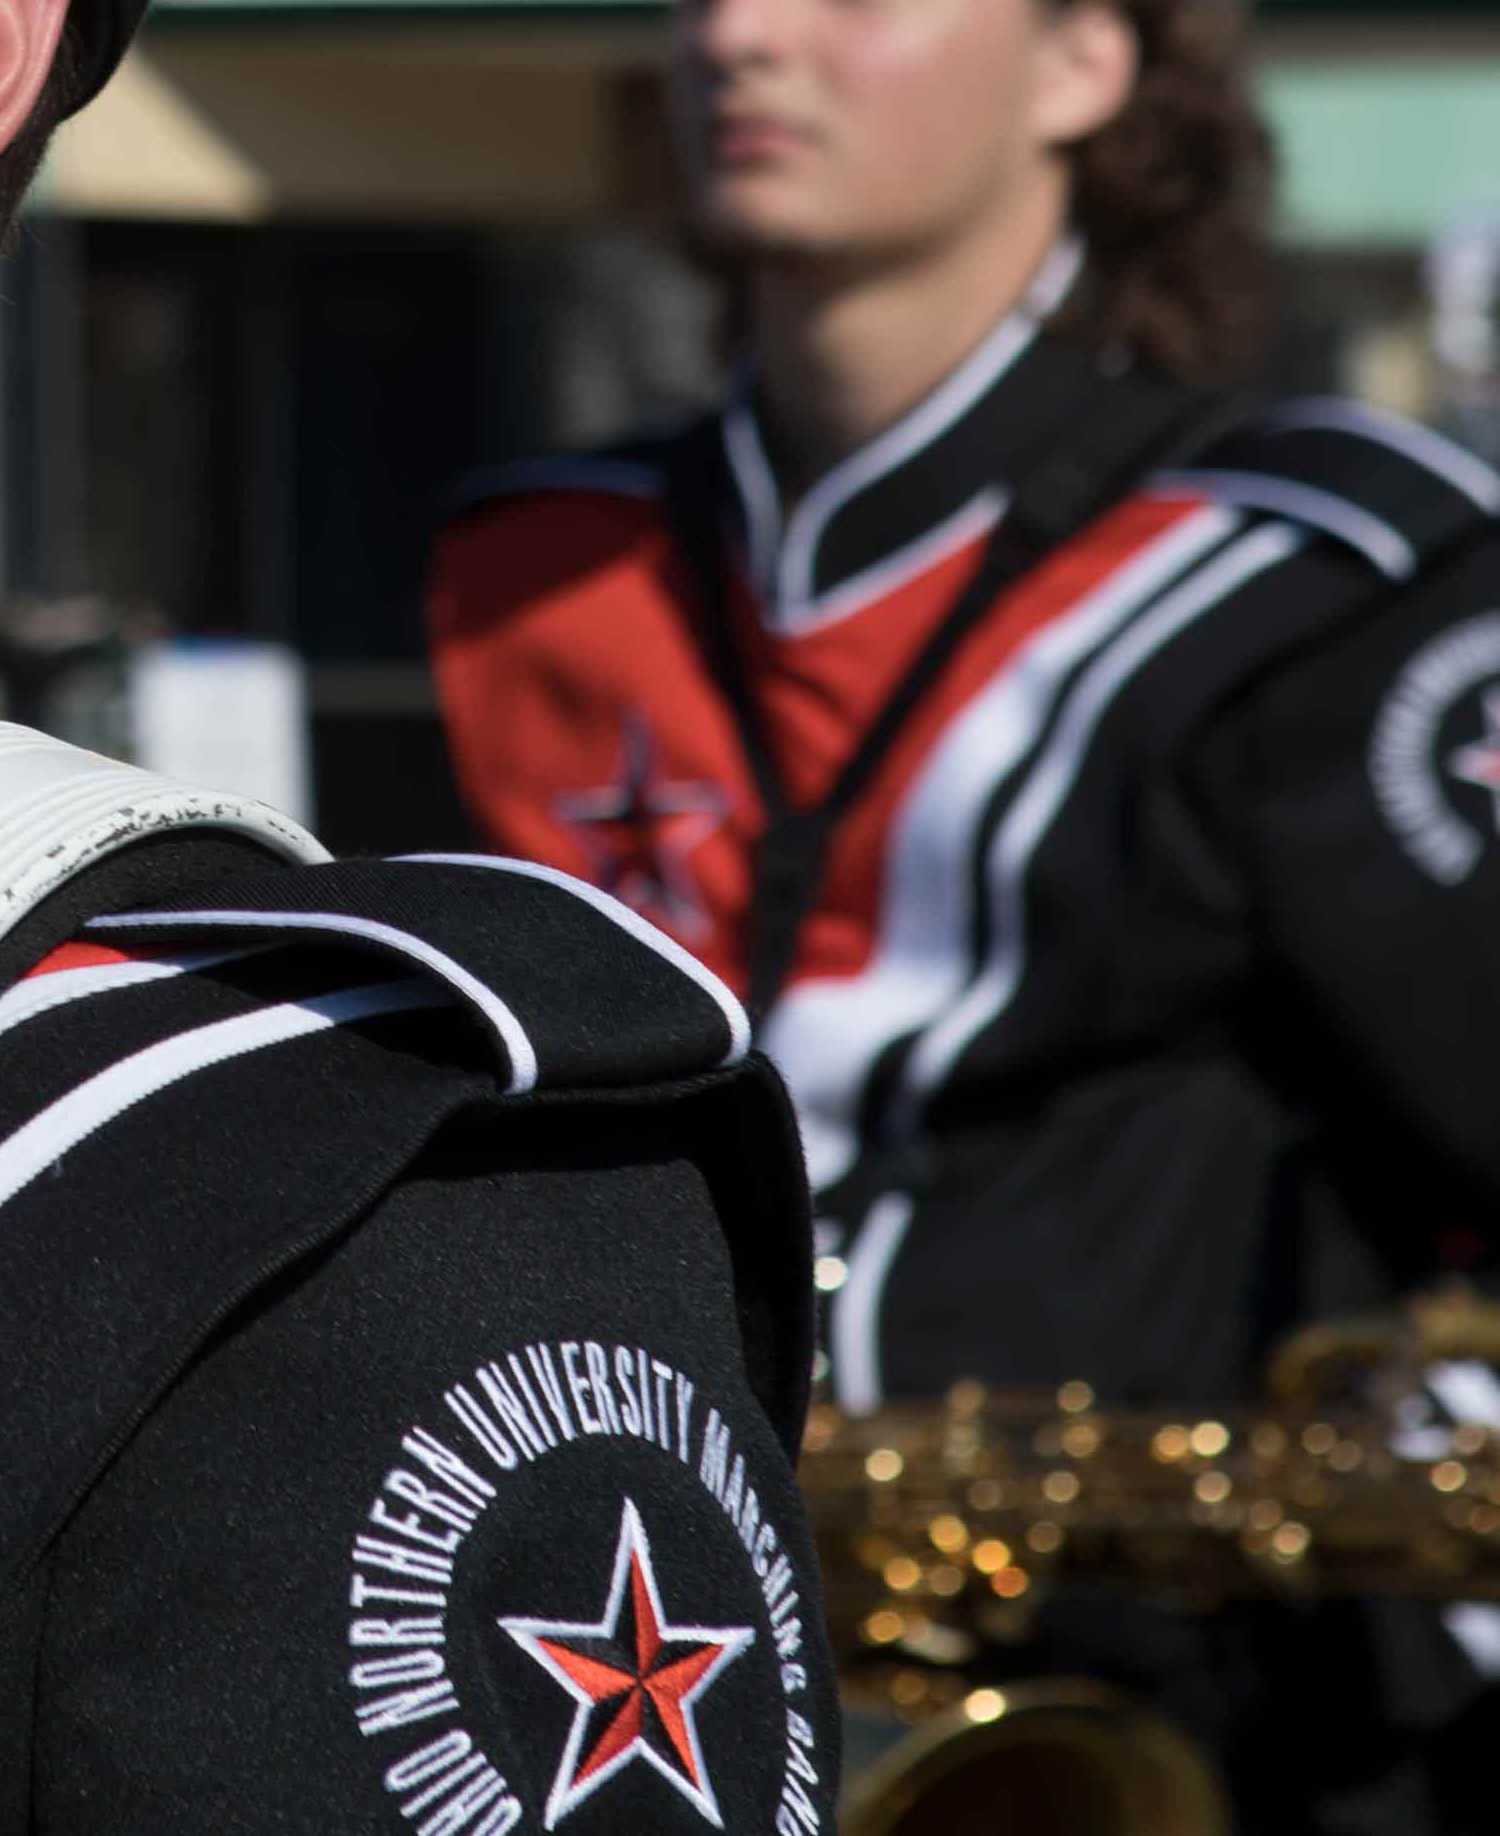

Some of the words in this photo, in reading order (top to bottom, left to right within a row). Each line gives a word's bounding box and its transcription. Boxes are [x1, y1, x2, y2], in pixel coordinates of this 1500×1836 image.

[350, 1428, 497, 1735] NORTHERN
[444, 1341, 694, 1470] UNIVERSITY
[699, 1408, 807, 1694] MARCHING
